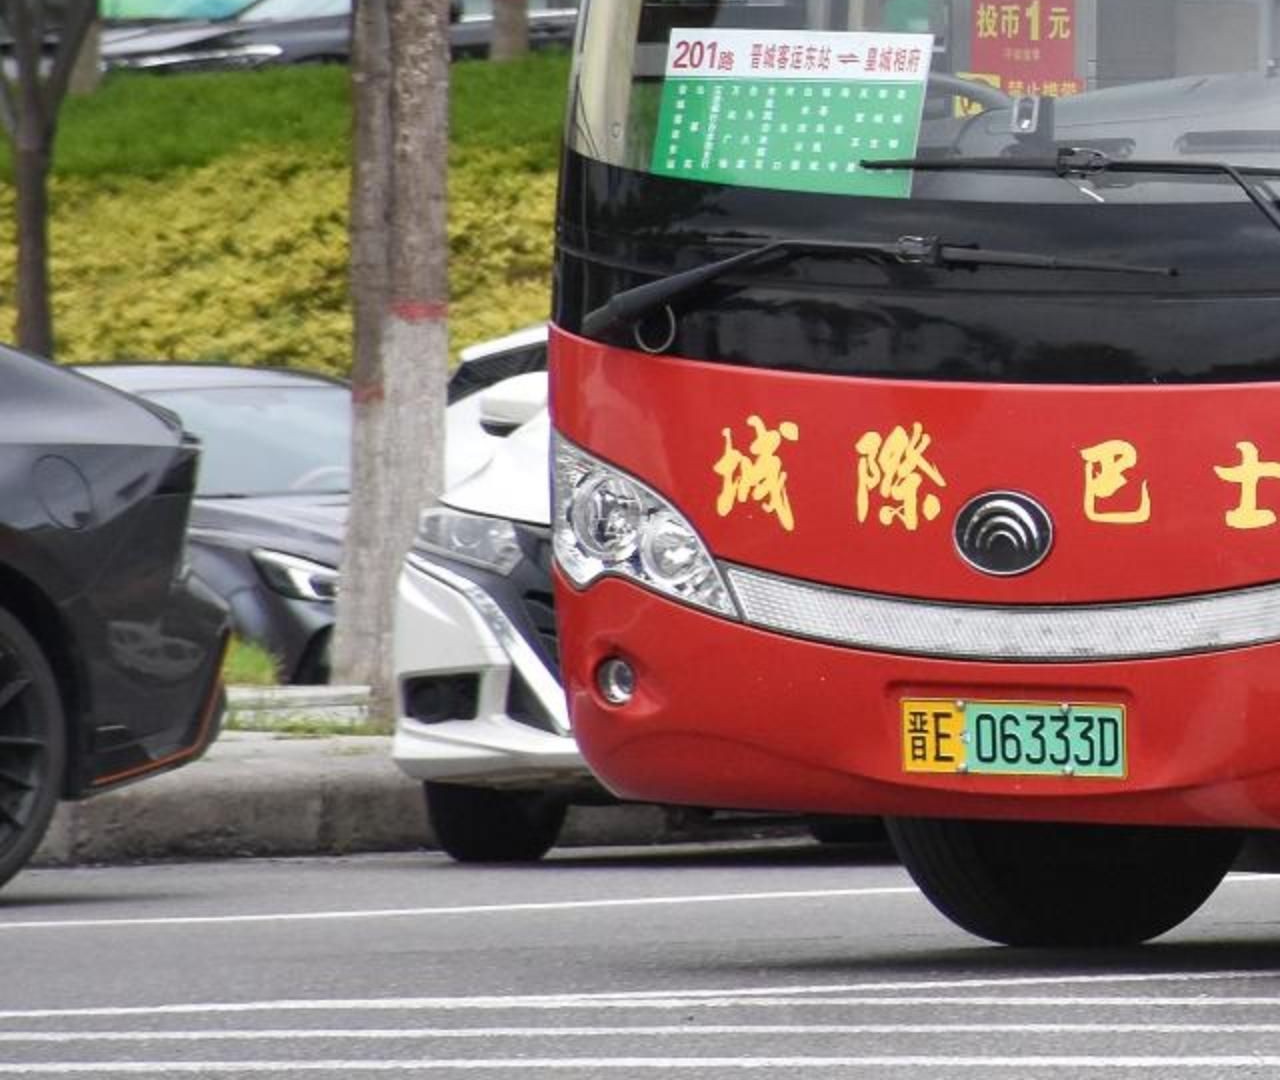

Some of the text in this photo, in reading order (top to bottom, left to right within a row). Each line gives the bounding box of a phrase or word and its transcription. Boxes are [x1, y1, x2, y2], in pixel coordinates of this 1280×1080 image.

[976, 0, 1071, 41] 投币1元
[672, 40, 735, 71] 201路
